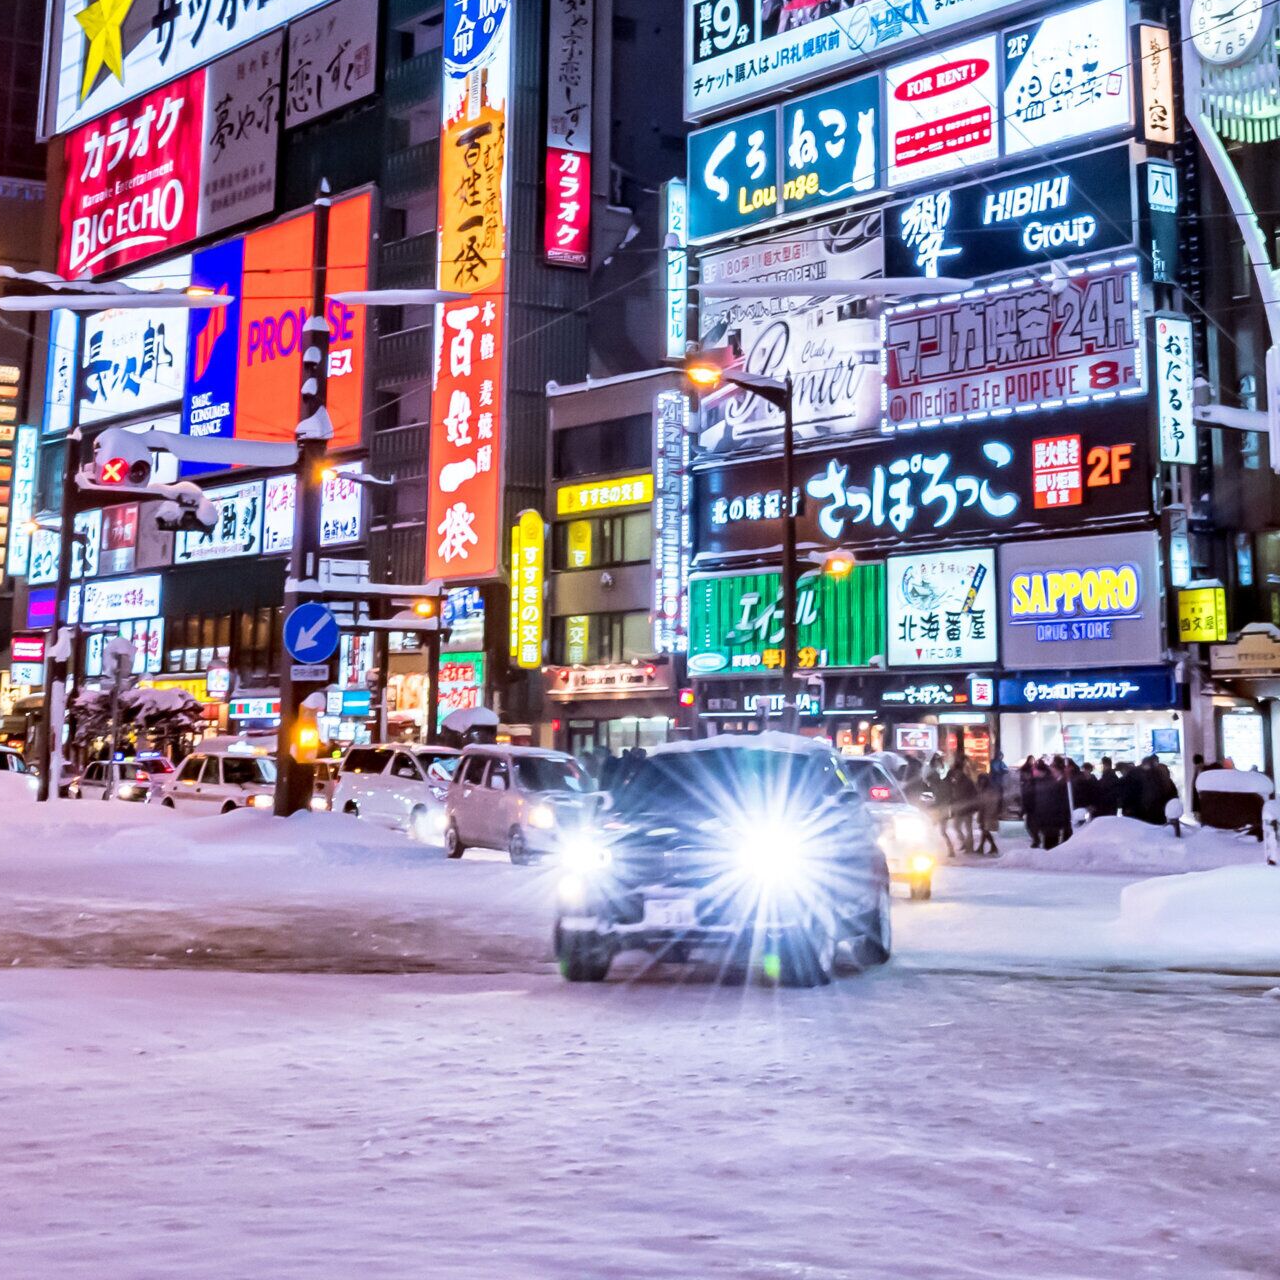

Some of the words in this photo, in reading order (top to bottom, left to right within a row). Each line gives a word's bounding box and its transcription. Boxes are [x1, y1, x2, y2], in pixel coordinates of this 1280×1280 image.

[699, 2, 713, 58] 地下鉄
[1007, 34, 1029, 59] 2F
[1226, 41, 1234, 55] 6
[906, 77, 933, 98] FOR
[80, 96, 184, 183] カラオケ
[704, 109, 847, 201] くろねこ
[556, 152, 580, 246] カラオケ
[739, 172, 819, 214] Lounge
[983, 176, 1070, 226] HIBIKI
[1023, 215, 1096, 252] Group
[248, 298, 354, 368] PROSE
[909, 385, 958, 420] Media
[961, 378, 1001, 412] Cafe
[1004, 363, 1079, 406] POPEYE
[807, 441, 1018, 539] さっぽろっこ
[1086, 444, 1132, 488] 2F
[579, 480, 644, 506] すすきの交番
[521, 546, 541, 664] すすきの交番
[1011, 565, 1139, 618] SAPPORO
[898, 609, 986, 642] 北海番屋
[1037, 623, 1068, 641] DRUG
[1072, 621, 1112, 639] STORE
